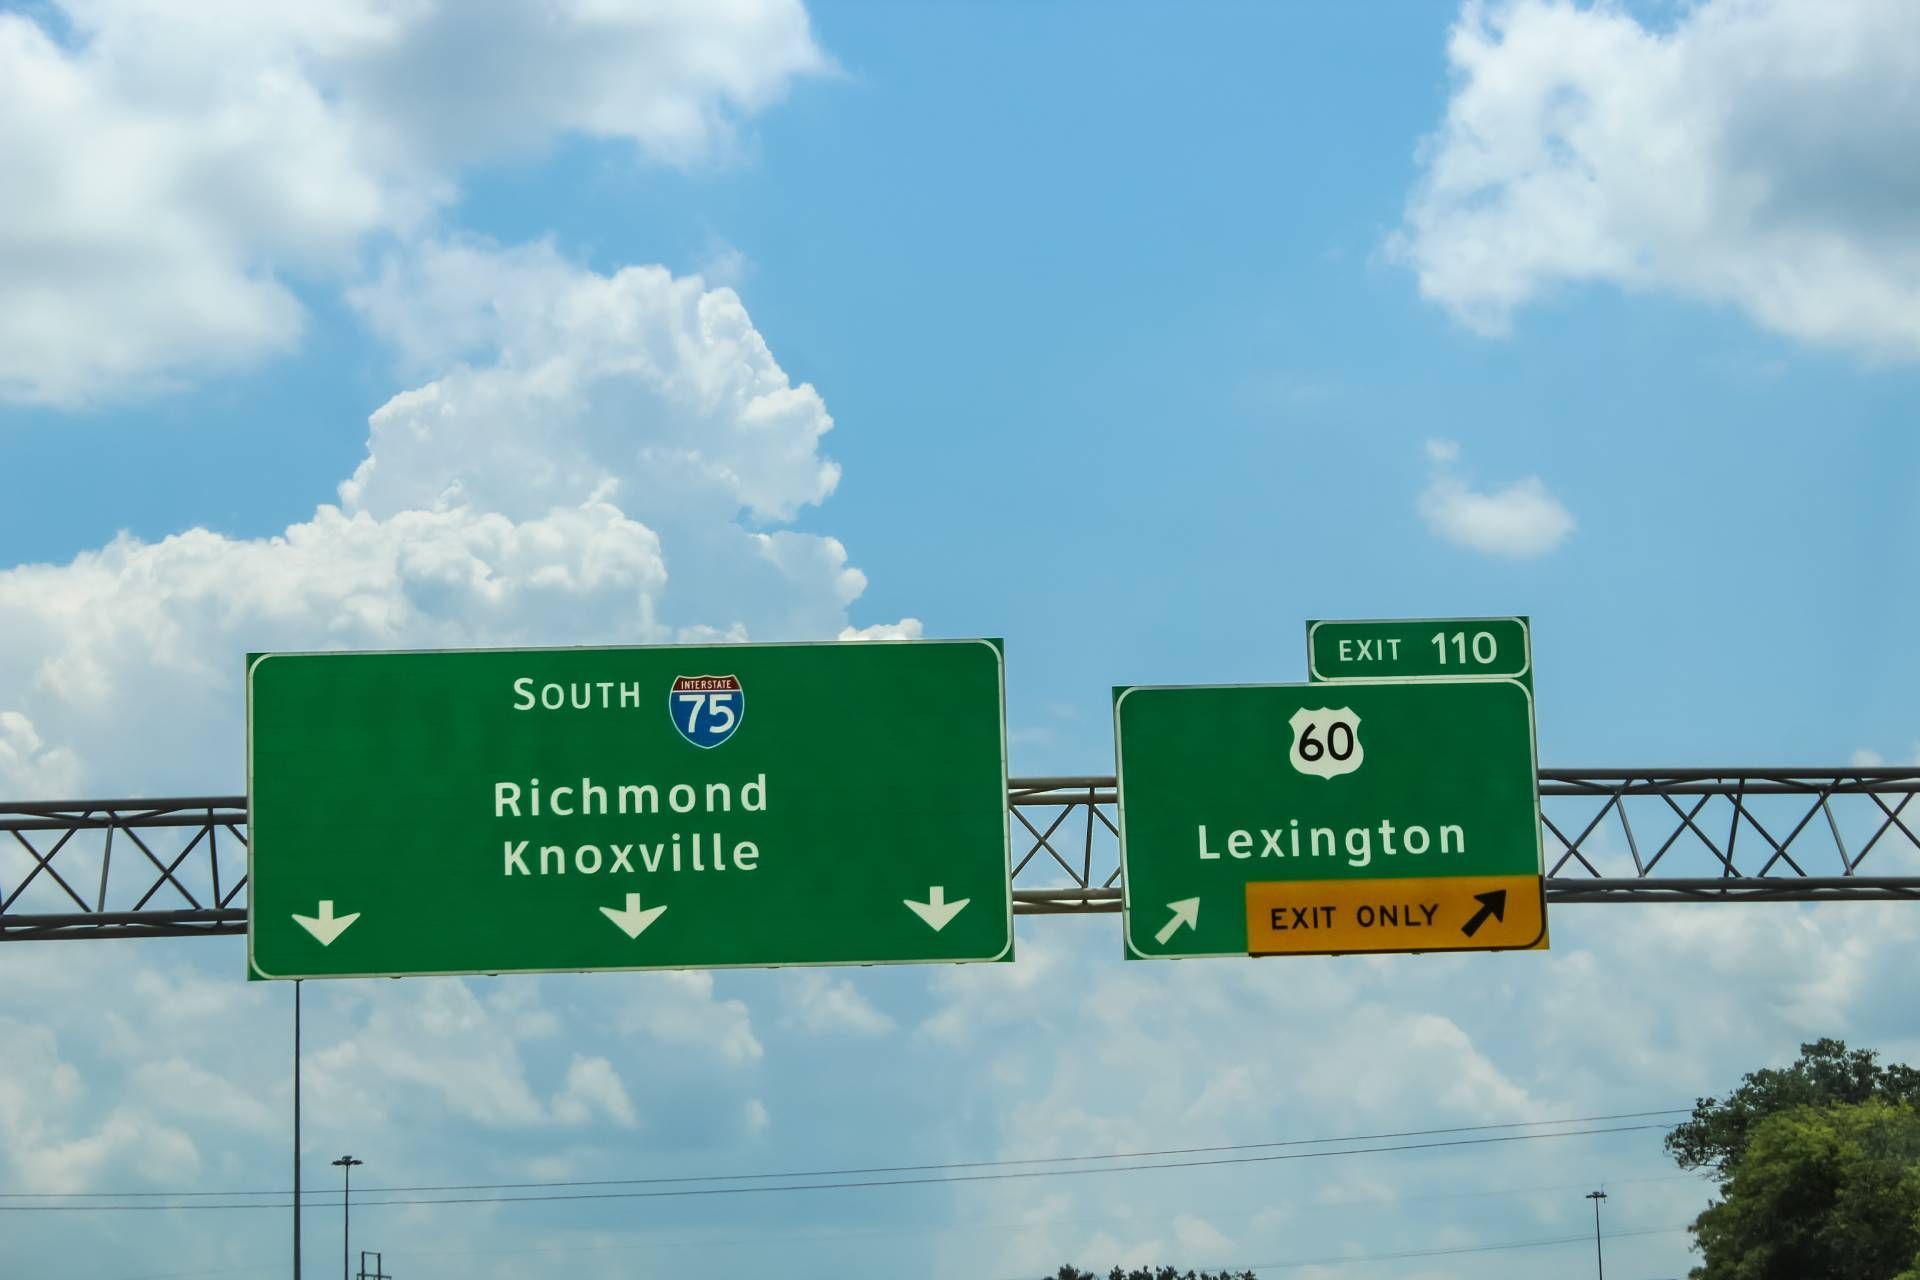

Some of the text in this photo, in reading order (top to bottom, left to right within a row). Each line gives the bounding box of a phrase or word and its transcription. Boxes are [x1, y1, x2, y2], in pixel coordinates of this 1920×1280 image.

[1339, 631, 1497, 665] EXIT 110
[513, 677, 640, 711] SOUTH
[681, 679, 732, 690] INTERSTATE
[679, 693, 735, 734] 75
[1298, 721, 1354, 762] 60
[494, 773, 767, 817] Richmond
[503, 832, 760, 876] Knoxville
[1198, 819, 1466, 867] Lexington
[1271, 904, 1440, 931] EXIT ONLY
